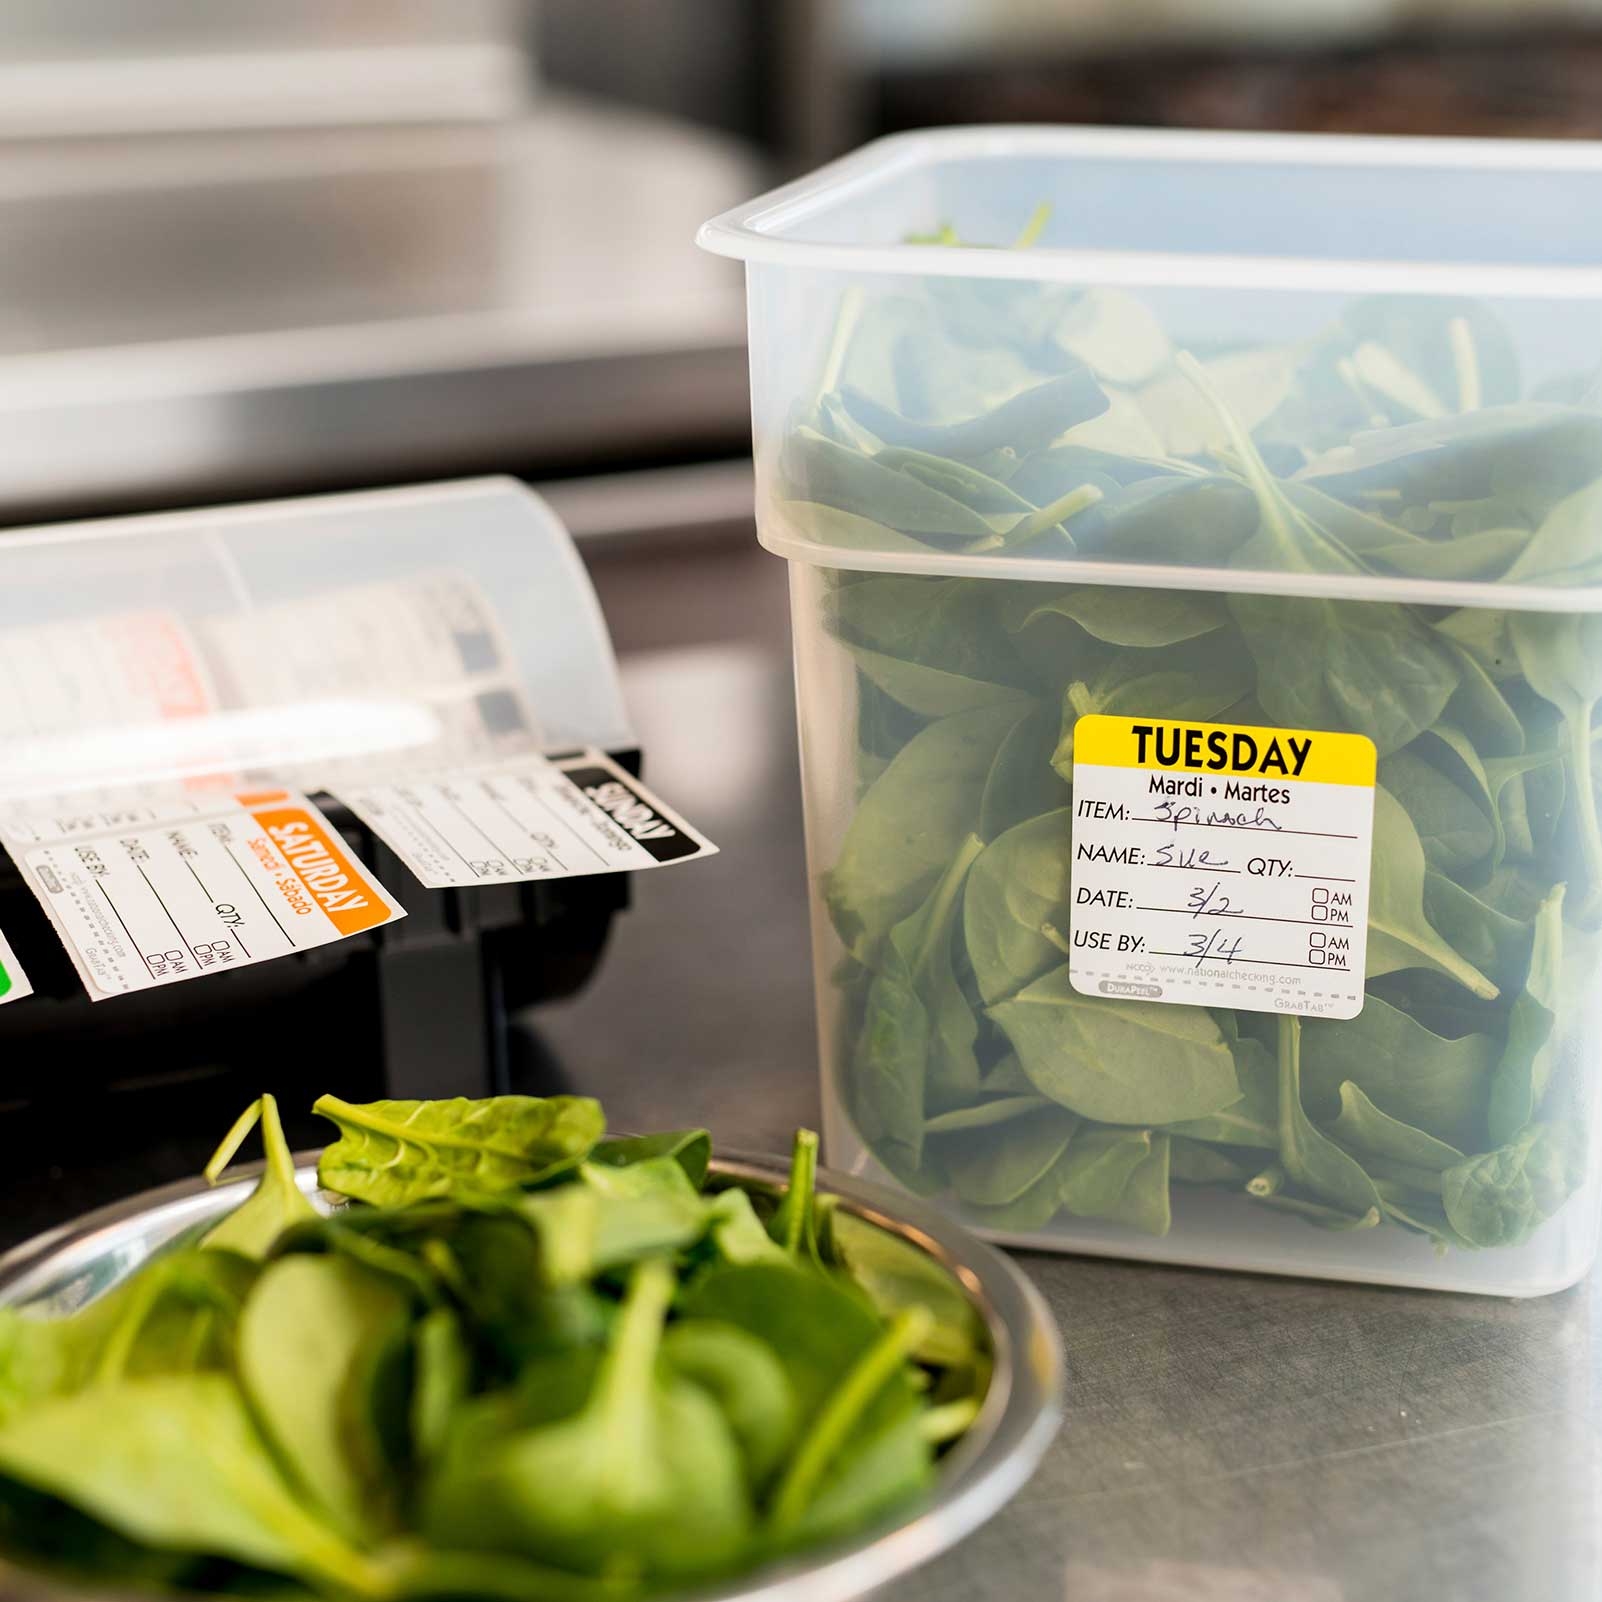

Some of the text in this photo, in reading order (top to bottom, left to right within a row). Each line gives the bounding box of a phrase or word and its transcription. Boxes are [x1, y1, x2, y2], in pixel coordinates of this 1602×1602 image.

[1131, 725, 1312, 776] TUESDAY
[1148, 774, 1291, 804] Mardi Martes
[583, 781, 676, 840] SUNDAY
[1078, 799, 1130, 821] ITEM:
[268, 821, 369, 912] SATURDAY
[1077, 843, 1293, 877] NAME: QTY:
[275, 877, 313, 915] Sábado
[1076, 887, 1133, 908] DATE:
[1187, 882, 1244, 919] 3/2
[1330, 892, 1352, 906] AM
[215, 903, 245, 928] QTY:
[1330, 908, 1349, 922] PM
[1074, 930, 1145, 953] USE BY:
[1182, 928, 1242, 968] 3/4
[1328, 937, 1350, 950] AM
[169, 961, 189, 974] AM
[200, 952, 218, 966] PM
[216, 951, 235, 963] AM
[1327, 952, 1346, 966] PM
[153, 962, 170, 977] PM
